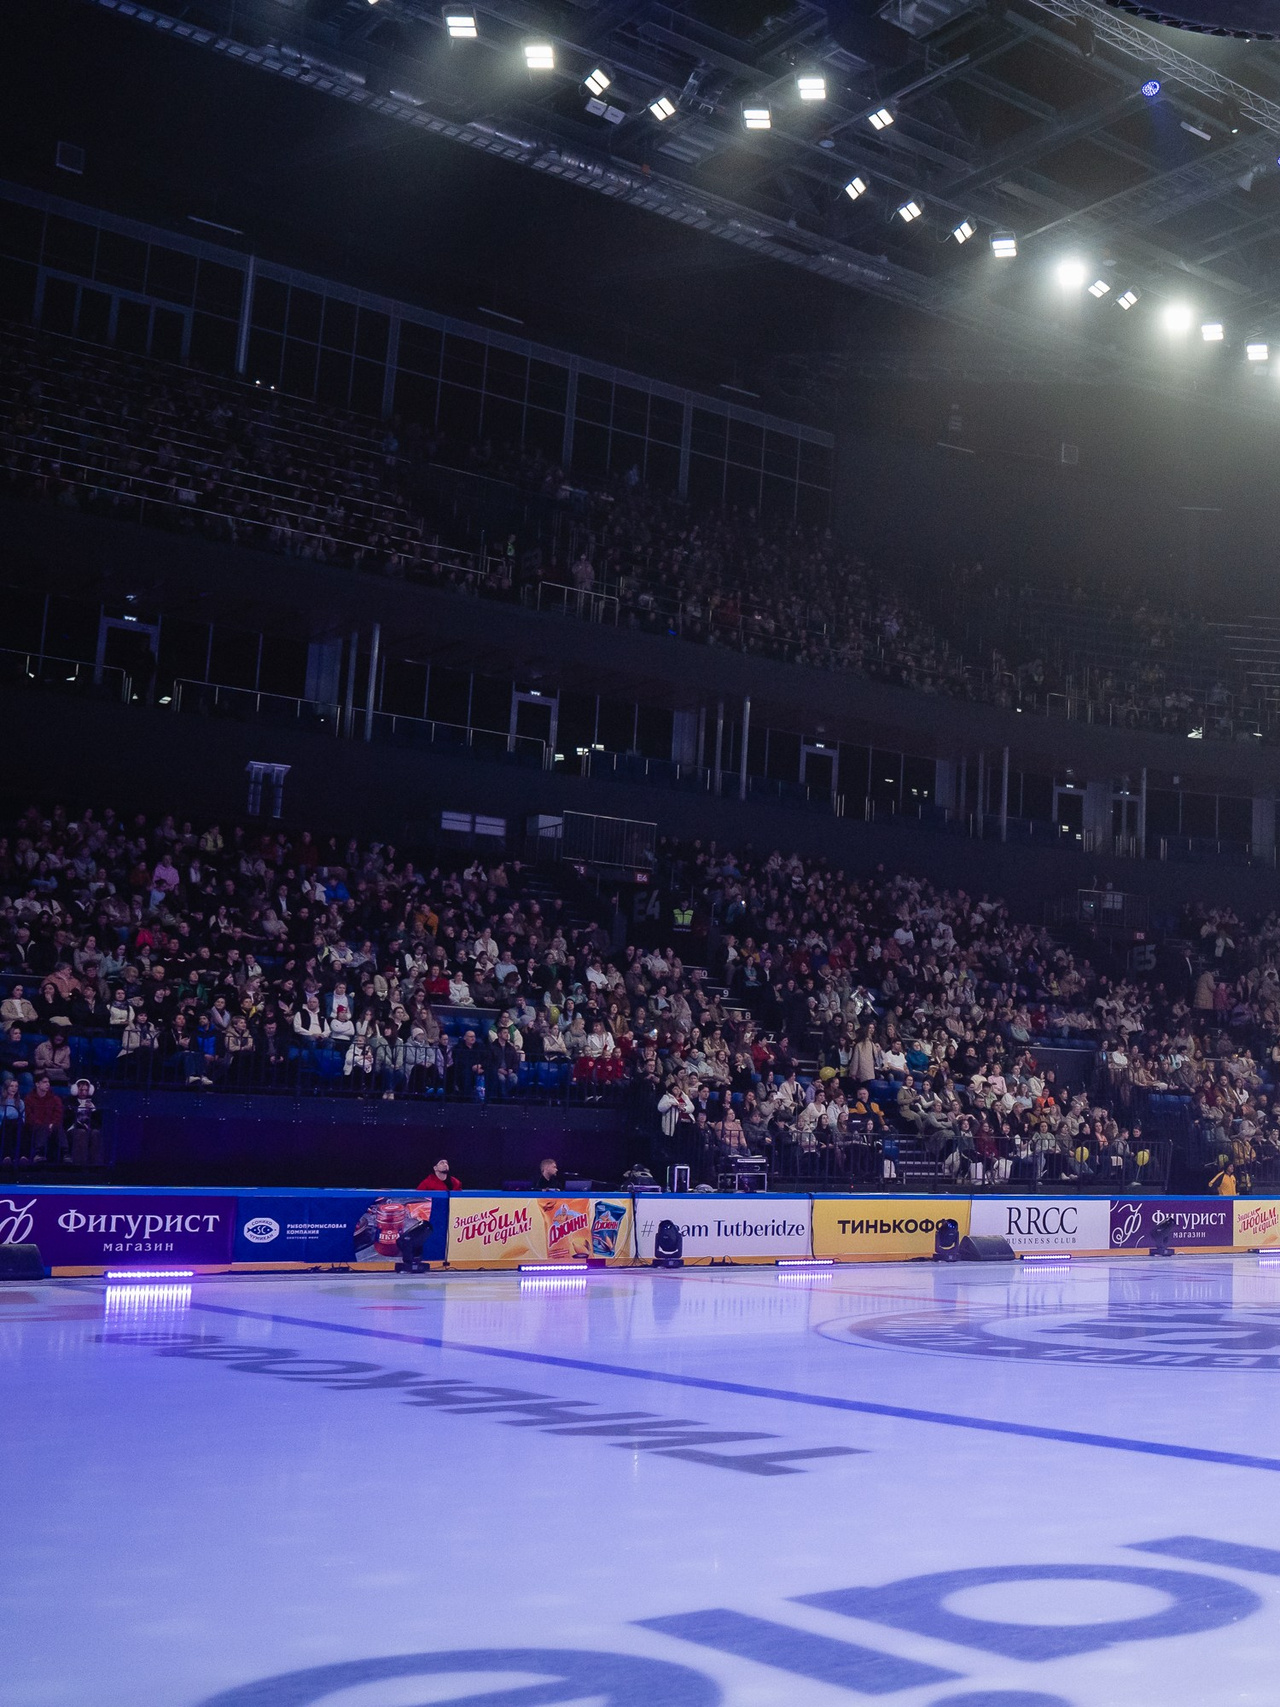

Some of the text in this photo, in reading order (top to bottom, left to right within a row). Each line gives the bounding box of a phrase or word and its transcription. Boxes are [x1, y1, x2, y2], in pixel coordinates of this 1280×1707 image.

[636, 873, 649, 883] E4
[634, 890, 660, 923] E4
[1133, 945, 1156, 971] E5
[722, 989, 729, 998] 9
[745, 1012, 751, 1020] 8
[768, 1034, 774, 1042] 7
[57, 1209, 221, 1239] Фигурист
[453, 1210, 491, 1229] Знаем,
[457, 1207, 528, 1243] любим
[713, 1219, 805, 1238] Tutberidze
[1006, 1206, 1078, 1236] RRCC
[1239, 1207, 1276, 1233] любим
[1253, 1214, 1279, 1235] и едим!
[257, 1225, 267, 1234] SC
[483, 1217, 532, 1246] и едим!
[1173, 1231, 1206, 1239] магазин
[103, 1241, 174, 1252] магазин
[1007, 1237, 1050, 1245] BUSINESS
[87, 1332, 872, 1476] ТИНЬКОФФ
